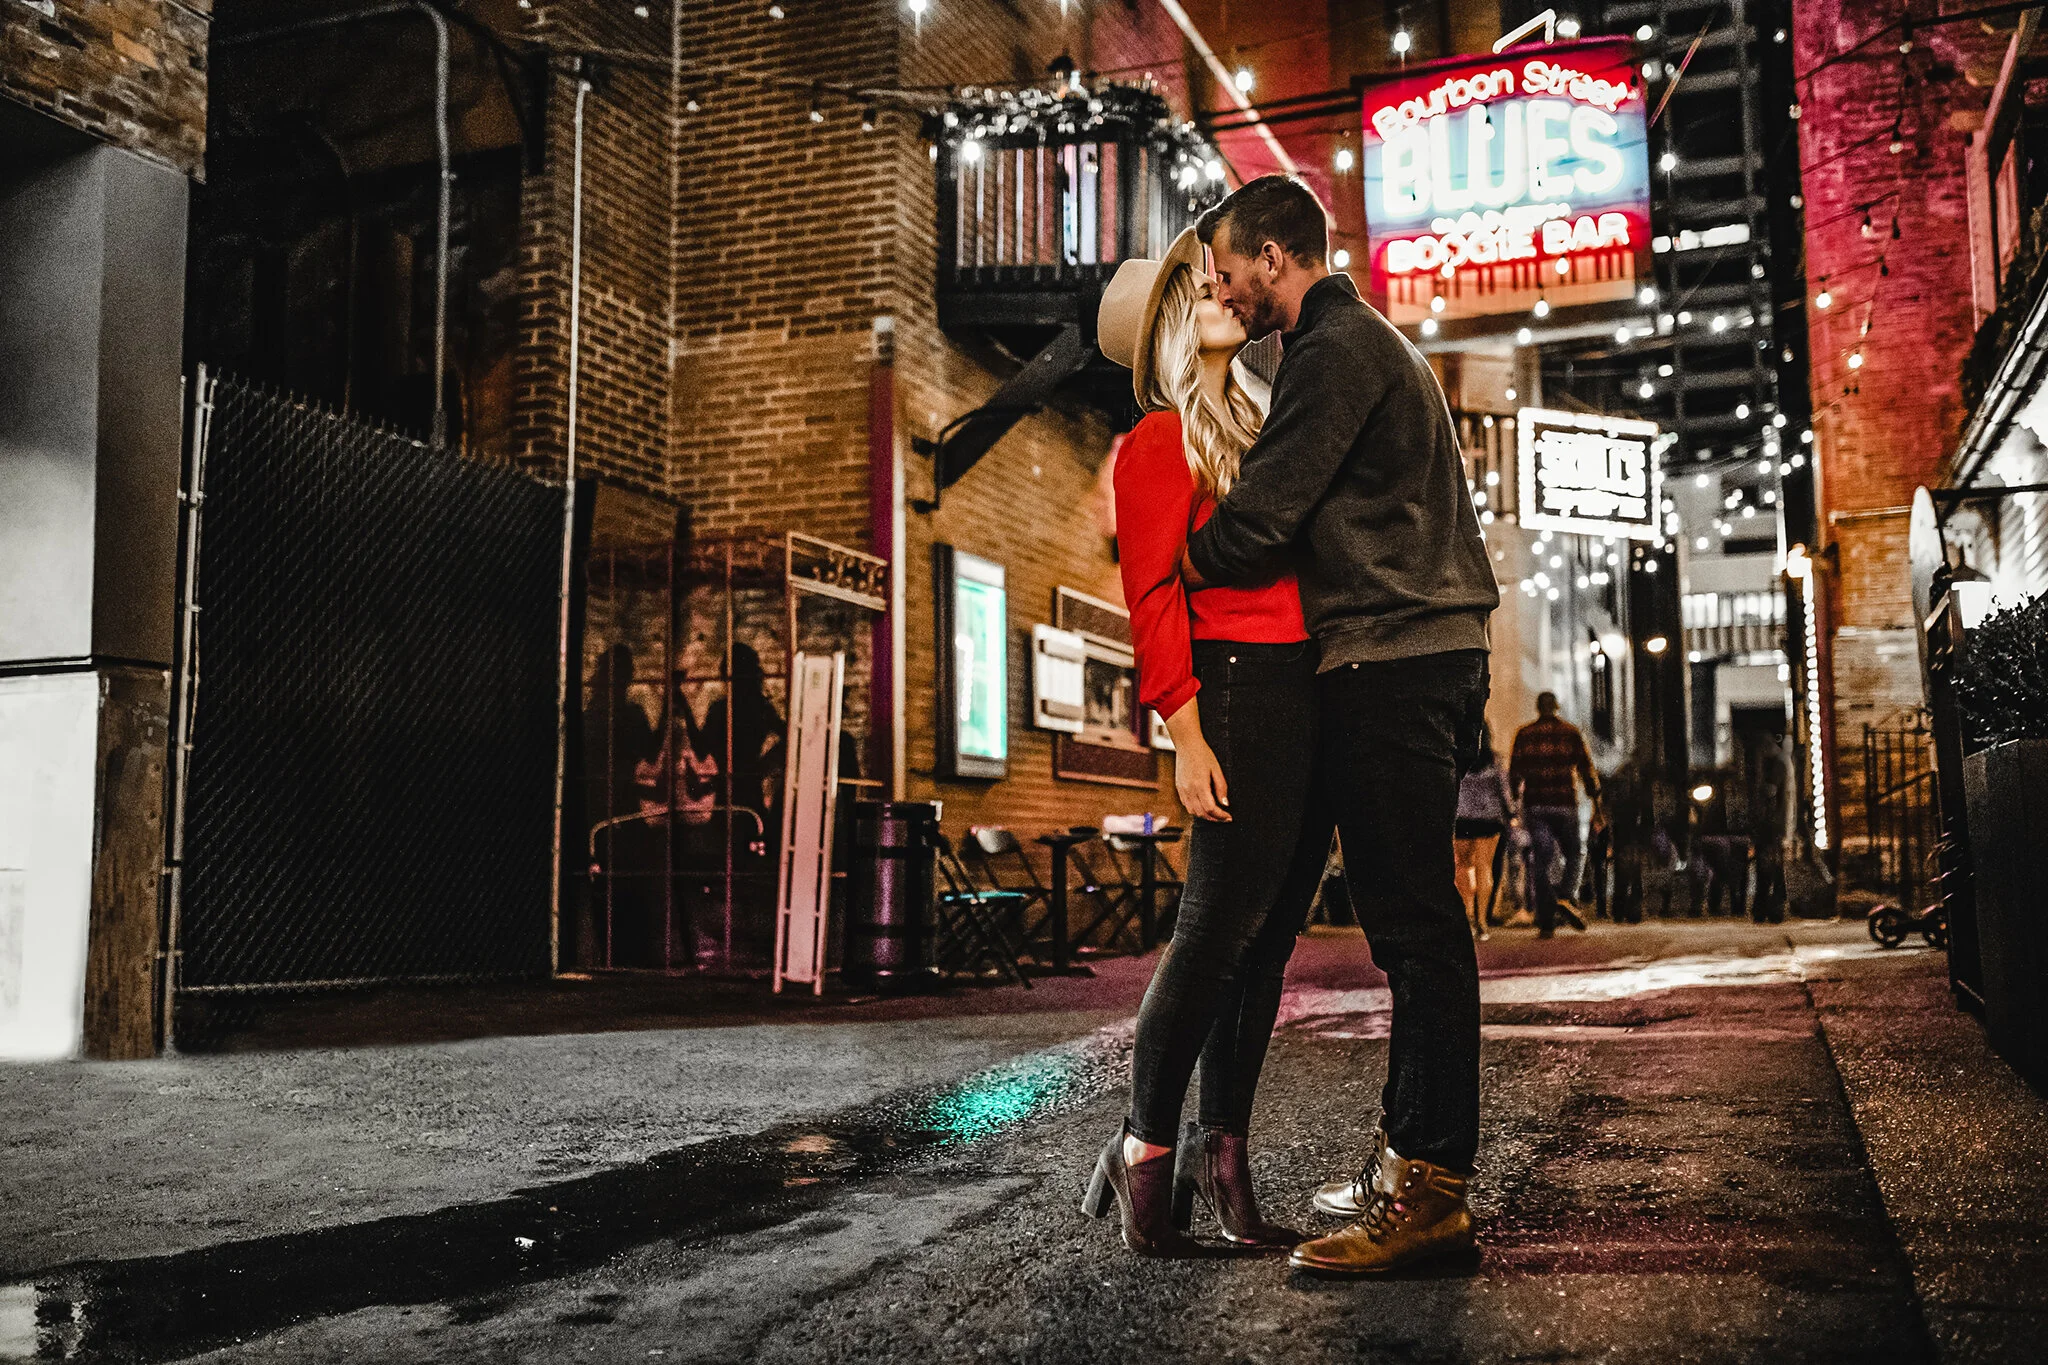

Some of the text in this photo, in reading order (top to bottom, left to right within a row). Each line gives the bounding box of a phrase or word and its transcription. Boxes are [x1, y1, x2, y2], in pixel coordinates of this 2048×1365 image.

[1372, 60, 1629, 141] Bourbon Street
[1381, 99, 1624, 217] BLUES
[1387, 225, 1537, 274] BOOGIE
[1543, 212, 1630, 254] BAR
